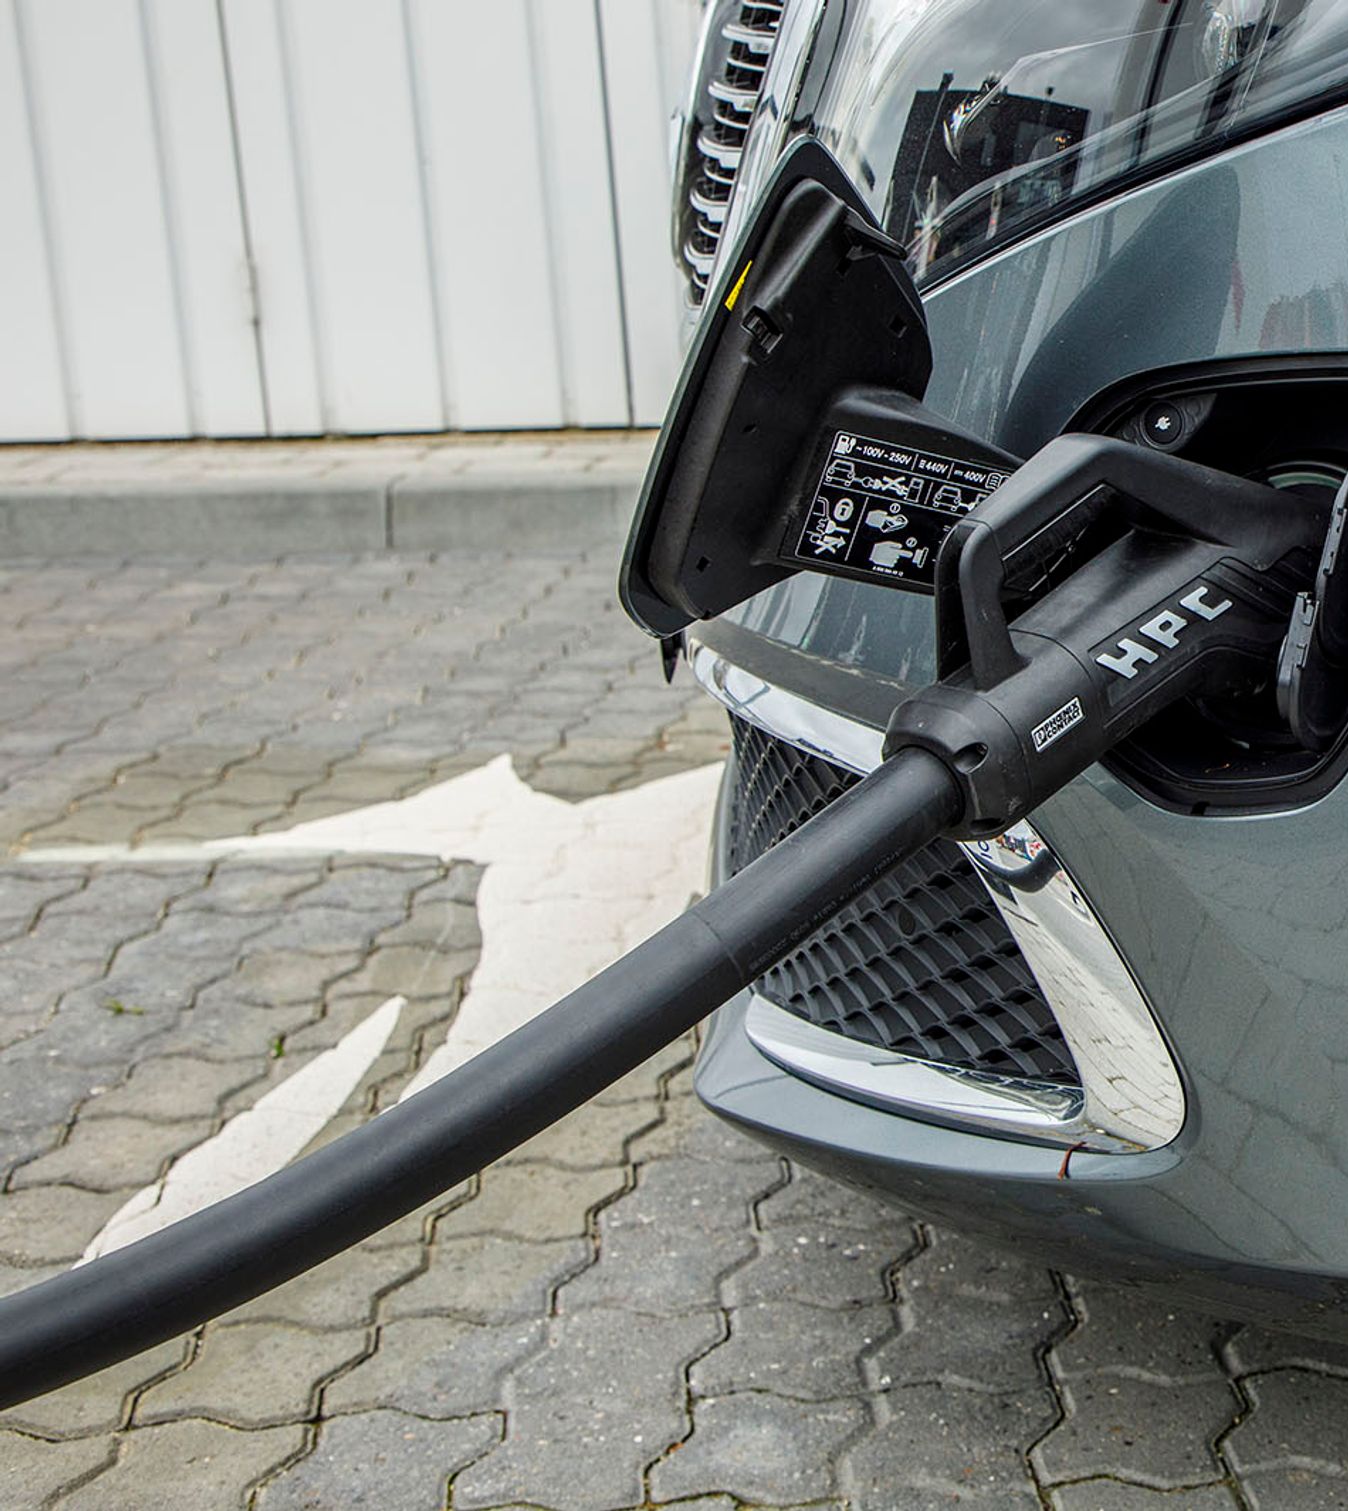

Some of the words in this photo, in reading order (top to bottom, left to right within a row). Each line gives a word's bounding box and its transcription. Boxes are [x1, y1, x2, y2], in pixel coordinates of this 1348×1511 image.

[888, 451, 913, 466] 250V
[1096, 586, 1233, 679] HPC
[1047, 707, 1080, 738] CONTACT
